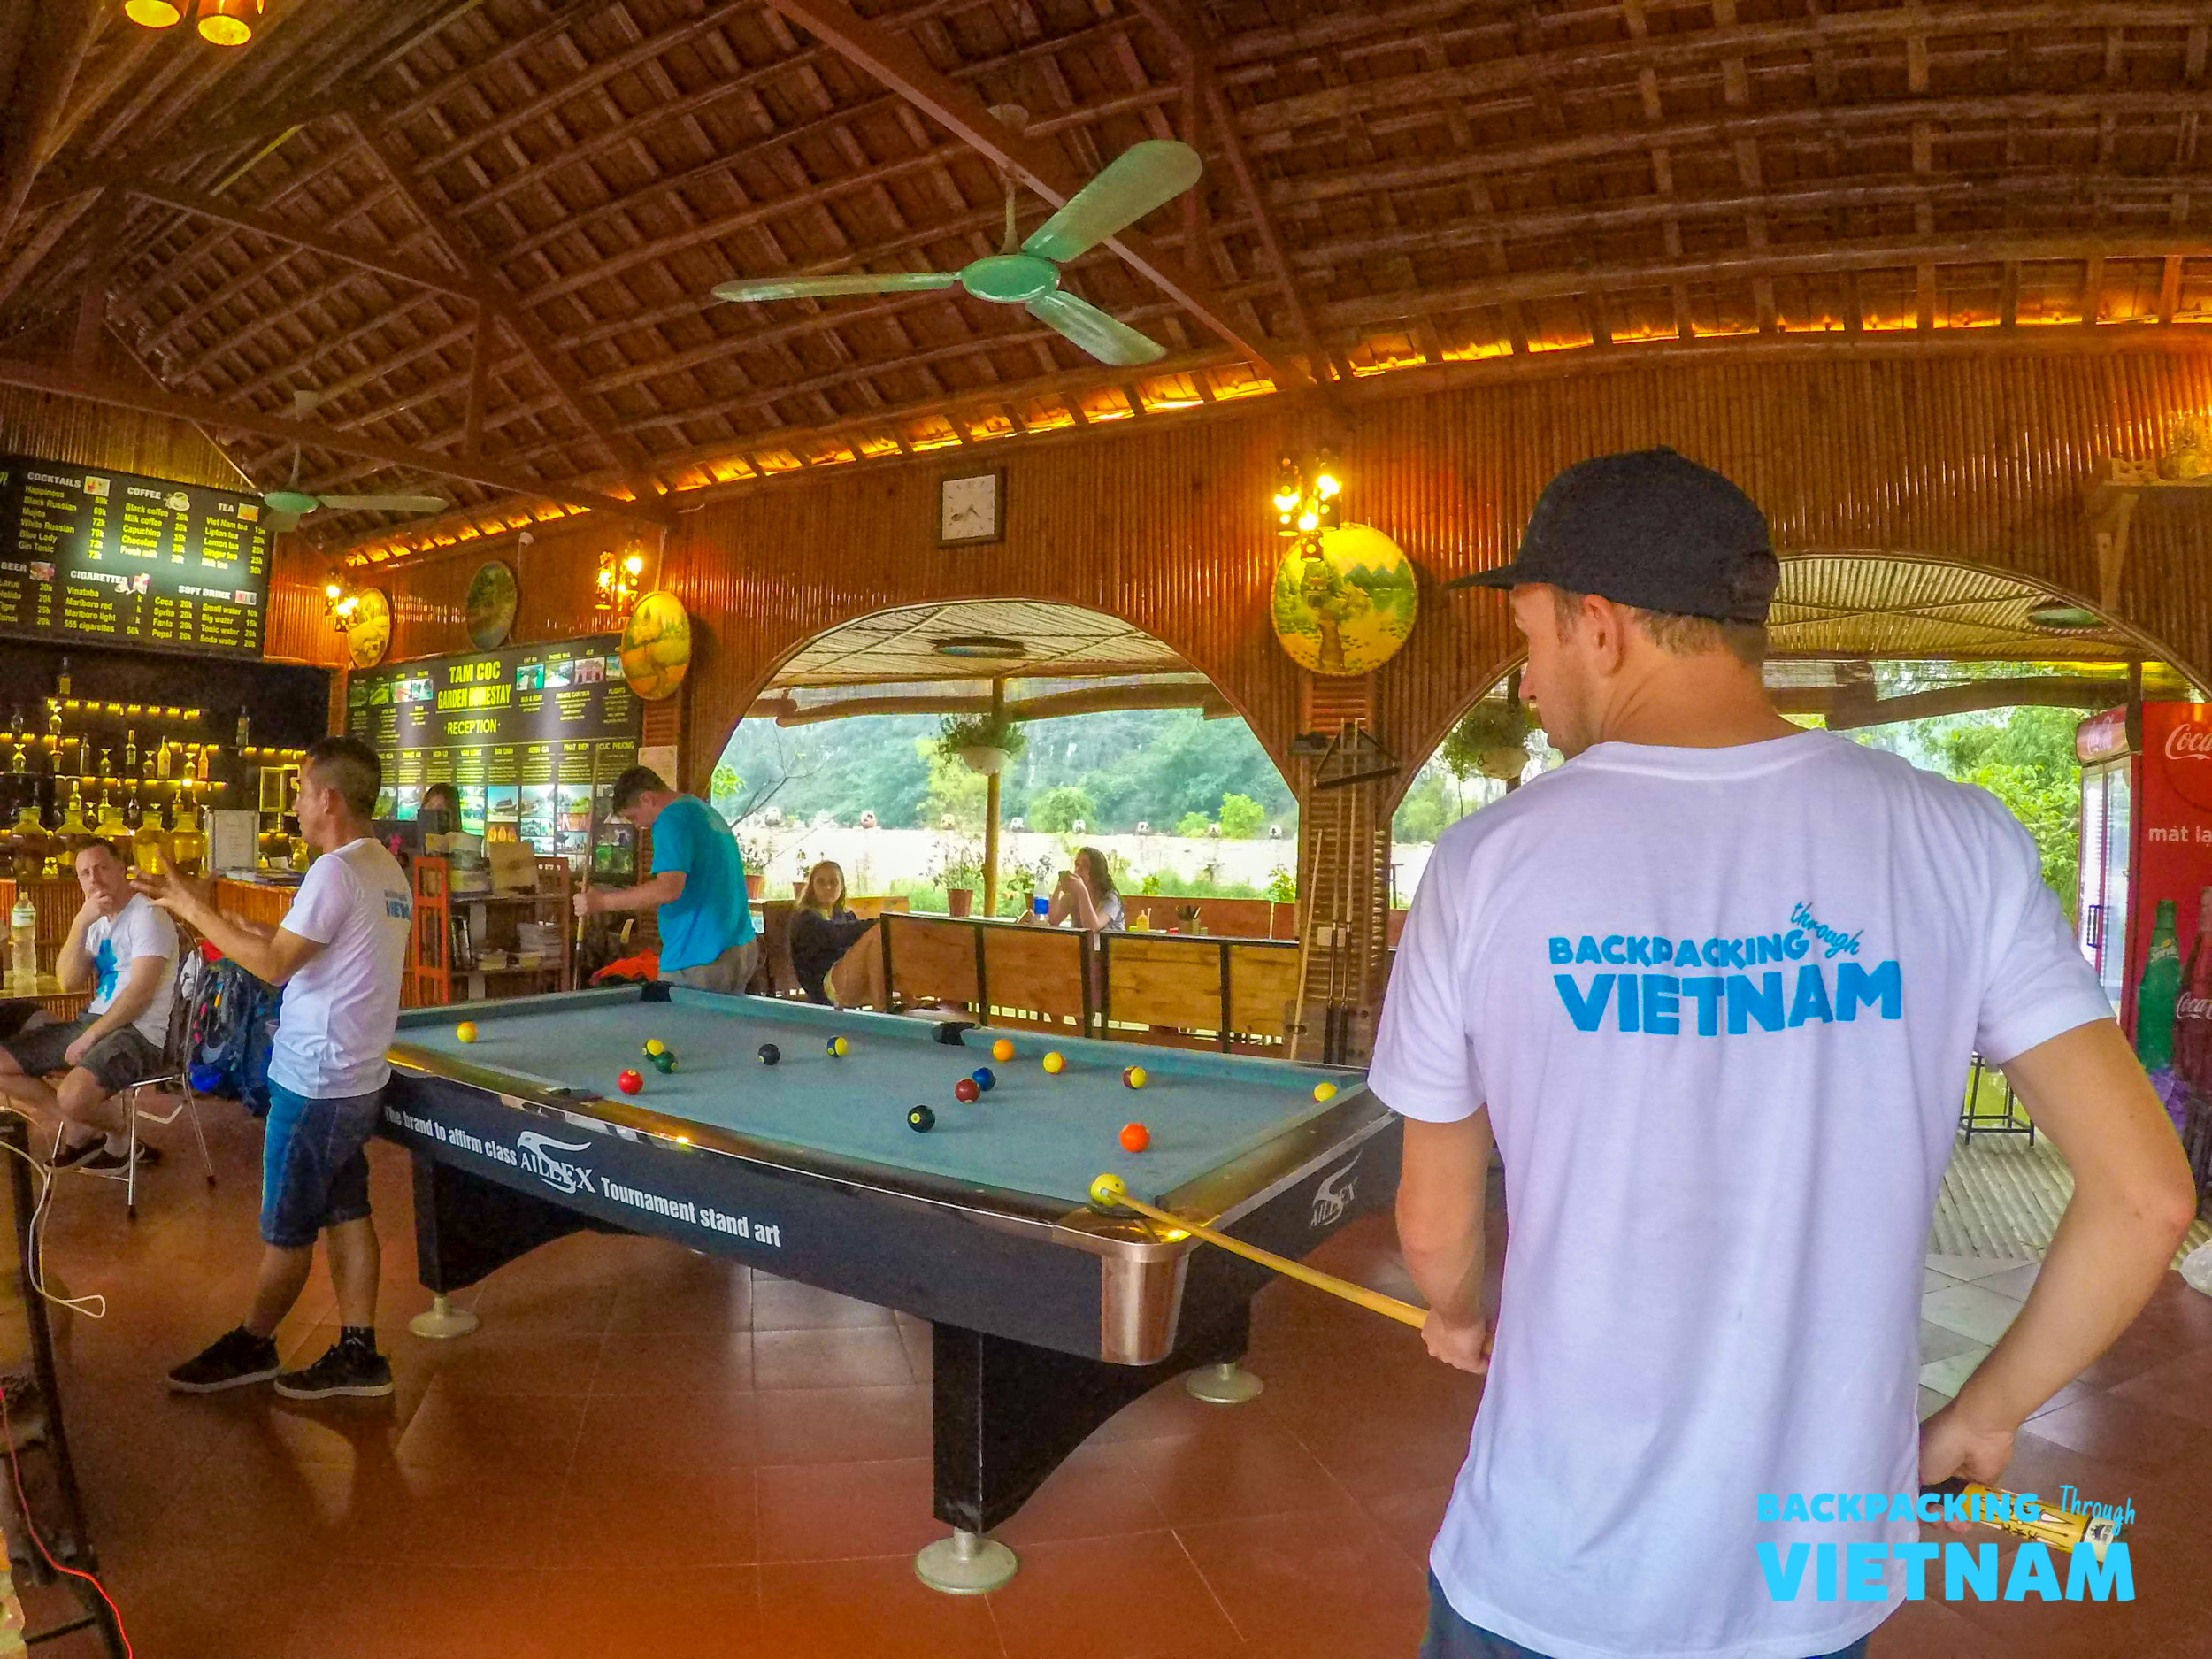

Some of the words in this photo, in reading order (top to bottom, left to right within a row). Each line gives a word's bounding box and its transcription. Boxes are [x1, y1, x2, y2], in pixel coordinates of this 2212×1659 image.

[27, 472, 81, 488] COCKTAILS
[127, 487, 162, 500] COFFEE
[46, 500, 77, 511] Russian
[218, 503, 234, 513] TEA
[125, 503, 146, 513] Black
[147, 507, 169, 518] coffee
[176, 512, 188, 522] 20k
[20, 518, 43, 529] White
[44, 522, 74, 534] Russian
[92, 518, 105, 527] 72k
[123, 513, 139, 523] Milk
[140, 518, 163, 527] coffee
[206, 516, 220, 526] Viet
[220, 520, 236, 529] Nam
[237, 522, 248, 531] tea
[122, 524, 162, 538] Capuchino
[204, 526, 227, 538] Lipton
[39, 534, 58, 543] Lady
[121, 534, 158, 548] Chocolate
[204, 537, 227, 549] Lemon
[228, 541, 239, 550] tea
[19, 541, 32, 549] Gin
[35, 543, 54, 553] Tonic
[202, 547, 227, 559] Ginger
[227, 551, 238, 561] tea
[1, 561, 27, 572] BEER
[70, 570, 128, 585] CIGARETTES
[39, 583, 53, 592] 20k
[66, 586, 99, 598] Vinataba
[178, 585, 202, 596] SOFT
[202, 588, 231, 600] DRINK
[38, 594, 52, 603] 20k
[65, 596, 99, 609] Marlboro
[100, 601, 113, 611] red
[154, 596, 173, 607] Coca
[180, 600, 193, 609] 20k
[65, 608, 98, 619] Marlboro
[99, 612, 116, 623] light
[153, 607, 175, 618] Sprite
[180, 611, 193, 619] 20k
[202, 603, 222, 613] Small
[222, 607, 242, 616] water
[152, 618, 173, 628] Fanta
[180, 621, 192, 630] 20k
[201, 613, 213, 624] Big
[78, 621, 115, 633] cigarettes
[201, 624, 219, 634] Tonic
[220, 626, 240, 636] water
[151, 629, 173, 639] Pepsi
[200, 634, 218, 644] Soda
[219, 636, 238, 646] water
[449, 664, 473, 684] TAM
[476, 661, 501, 681] COC
[437, 687, 468, 710] GARDEN
[447, 718, 497, 735] RECEPTION
[2148, 825, 2189, 842] mát
[1790, 901, 1864, 959] through
[1548, 929, 1810, 970] BACKPACKING
[1553, 960, 1903, 1037] VIETNAM
[2177, 991, 2208, 1019] Coca
[384, 1106, 402, 1125] The
[403, 1110, 434, 1137] brand
[434, 1121, 447, 1141] to
[449, 1128, 483, 1154] affirm
[484, 1140, 518, 1166] class
[600, 1176, 697, 1225] Tournament
[699, 1207, 749, 1239] stand
[754, 1223, 781, 1248] art
